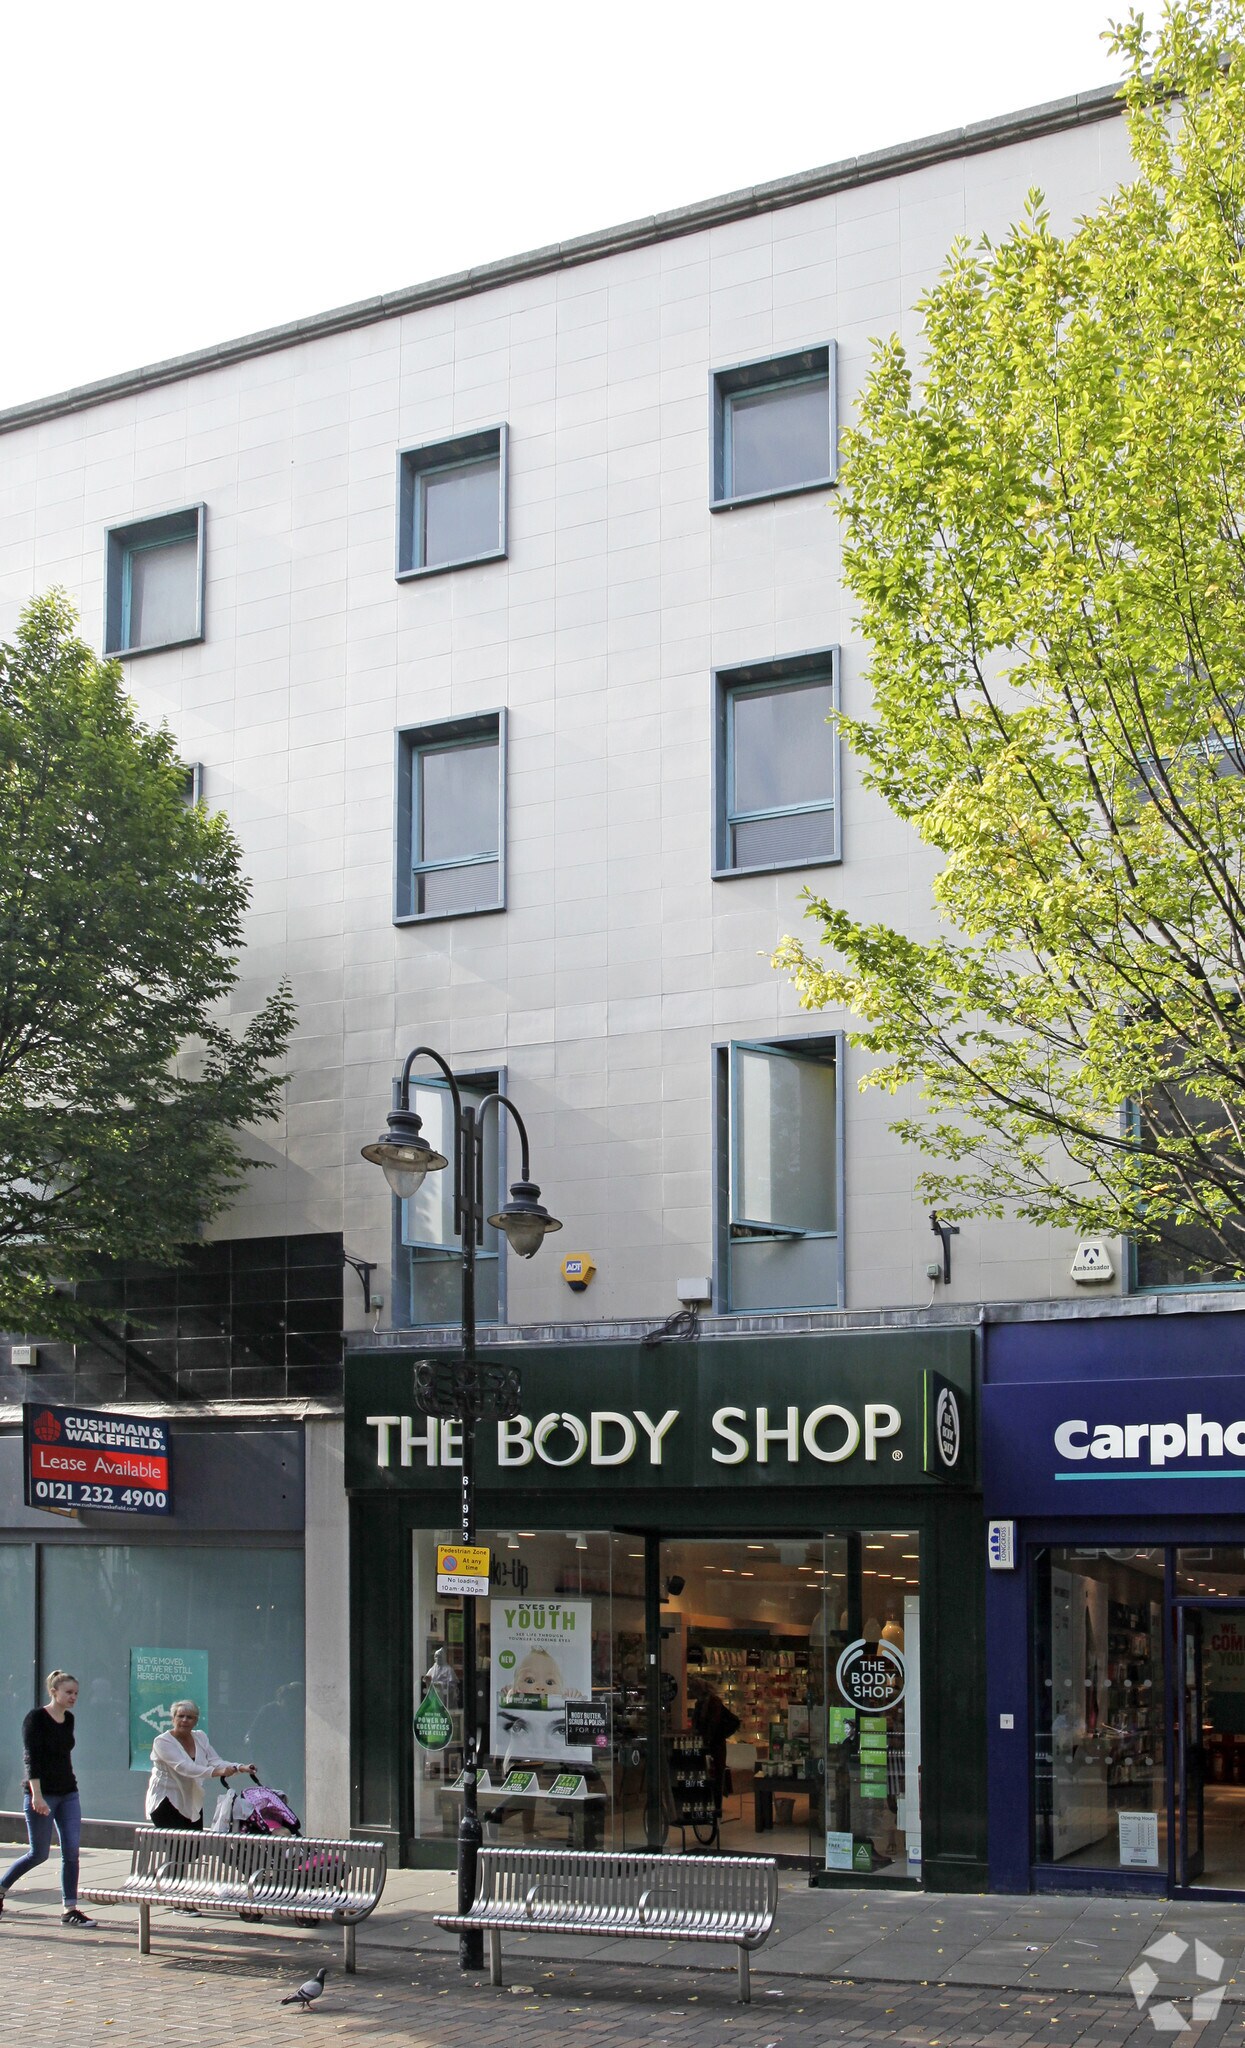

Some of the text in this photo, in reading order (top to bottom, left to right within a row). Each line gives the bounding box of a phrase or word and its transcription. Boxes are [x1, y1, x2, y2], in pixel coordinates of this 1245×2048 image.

[566, 1263, 582, 1271] ADT
[64, 1417, 164, 1439] CUSHMAN &
[366, 1415, 463, 1467] THE
[498, 1409, 680, 1467] BODY
[40, 1452, 161, 1478] Lease Available
[36, 1482, 166, 1508] 0121 232 4900
[68, 1502, 138, 1512] www.cushmanwakefield.com
[440, 1547, 471, 1555] Pedestrian
[504, 1610, 576, 1630] YOUTH
[1212, 1634, 1245, 1651] COM
[501, 1655, 514, 1664] NEW
[860, 1661, 885, 1672] THE
[852, 1672, 896, 1685] BODY
[854, 1686, 894, 1698] SHOP
